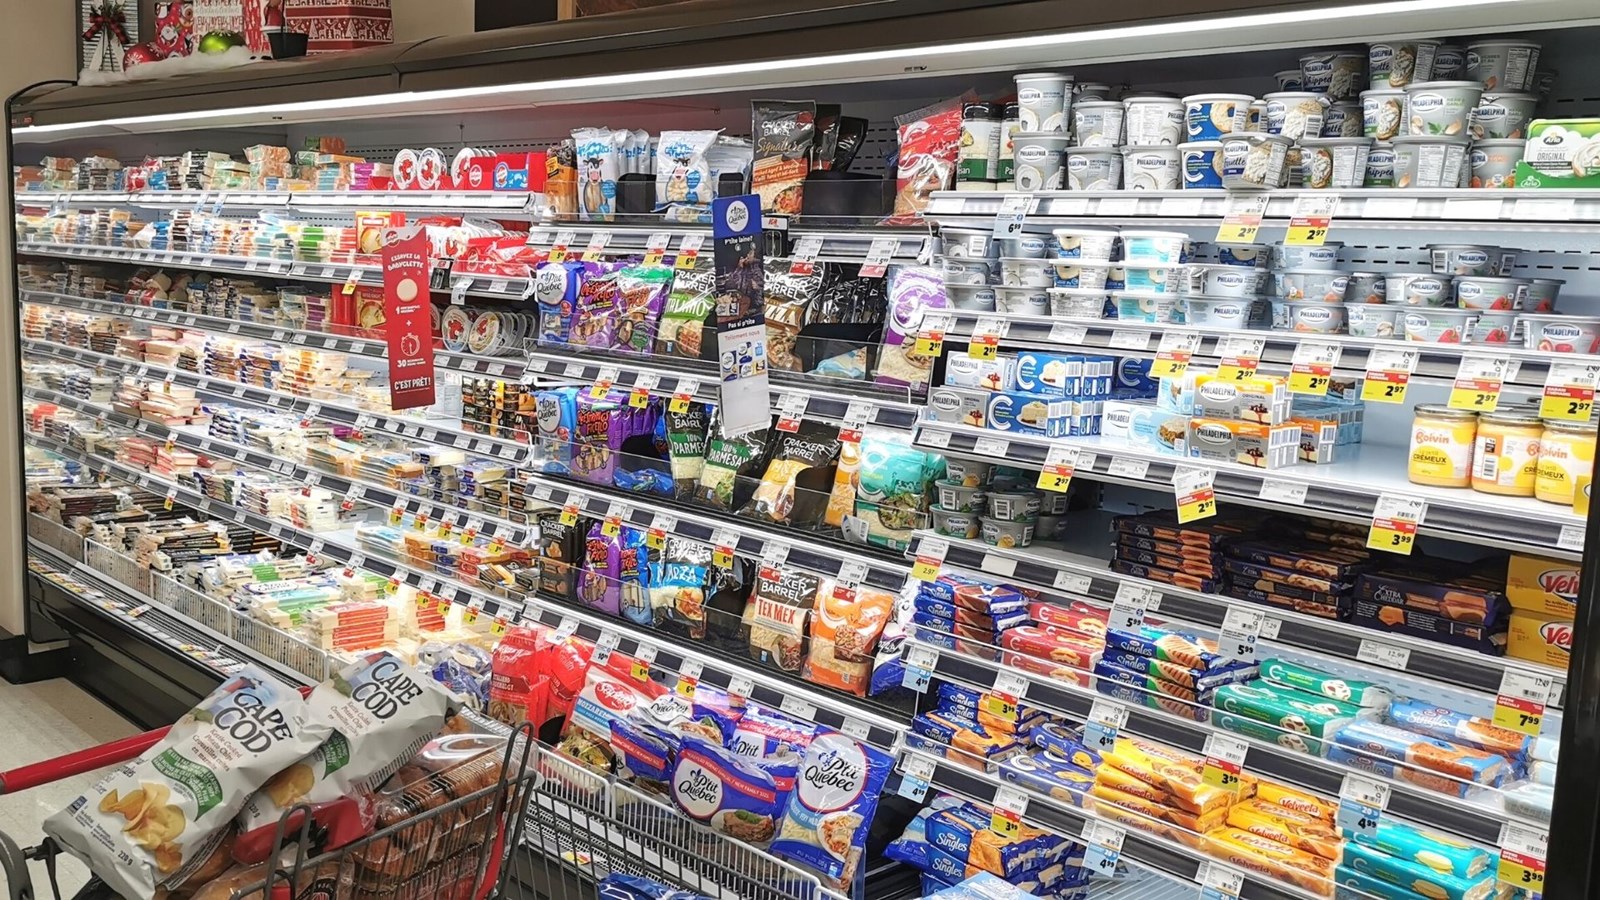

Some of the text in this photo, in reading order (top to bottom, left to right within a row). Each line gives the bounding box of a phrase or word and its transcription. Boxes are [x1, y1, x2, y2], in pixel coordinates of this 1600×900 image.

[1537, 152, 1566, 160] ORIGINAL
[1238, 228, 1256, 237] 297
[1306, 230, 1326, 240] 297
[536, 282, 562, 295] Québec
[1543, 328, 1580, 336] PHILADELPHIA
[929, 342, 940, 352] 297
[983, 346, 996, 356] 297
[950, 359, 978, 369] PHILADELPHIA
[1169, 364, 1186, 373] 297
[1236, 370, 1254, 380] 297
[394, 378, 412, 390] C'EST
[1309, 378, 1328, 388] 297
[1200, 385, 1236, 397] PHILADELPHIA
[1384, 386, 1404, 396] 297
[932, 396, 960, 406] PHILADELPHIA
[1474, 394, 1496, 405] 297
[1568, 402, 1590, 414] 297
[1197, 428, 1232, 440] PHILADELPHIA
[1416, 430, 1449, 444] Boivin
[784, 437, 822, 454] CRACKER
[784, 446, 815, 462] BARREL
[1413, 453, 1447, 464] CRÉMEUX
[1054, 477, 1069, 487] 297
[1198, 500, 1213, 513] 297
[540, 519, 566, 533] CRACKER
[1392, 534, 1412, 546] 399
[922, 568, 936, 576] 2.97
[779, 572, 808, 590] CKER
[761, 582, 800, 602] BARREL
[758, 599, 796, 624] TEX MEX
[1126, 618, 1142, 628] 599
[1120, 642, 1153, 656] Singles
[1238, 644, 1254, 656] 599
[1116, 656, 1146, 671] Singles
[371, 662, 424, 706] CAPE
[352, 682, 398, 720] COD
[233, 692, 294, 742] CAPE
[1519, 714, 1539, 727] 799
[214, 707, 272, 753] COD
[192, 734, 217, 759] Croustilles
[1100, 736, 1114, 746] 499
[827, 756, 860, 780] P'tit
[696, 776, 718, 793] P'tit
[804, 765, 855, 792] Québec
[1222, 774, 1238, 784] 399
[678, 779, 716, 805] Québec
[1280, 800, 1319, 814] Velveeta
[1006, 821, 1018, 832] 399
[1358, 817, 1377, 830] 499
[1250, 827, 1289, 843] Velveeta
[936, 834, 968, 853] Singles
[118, 850, 130, 862] 220
[932, 860, 963, 879] Singles
[1100, 860, 1115, 869] 499
[1522, 870, 1543, 883] 399
